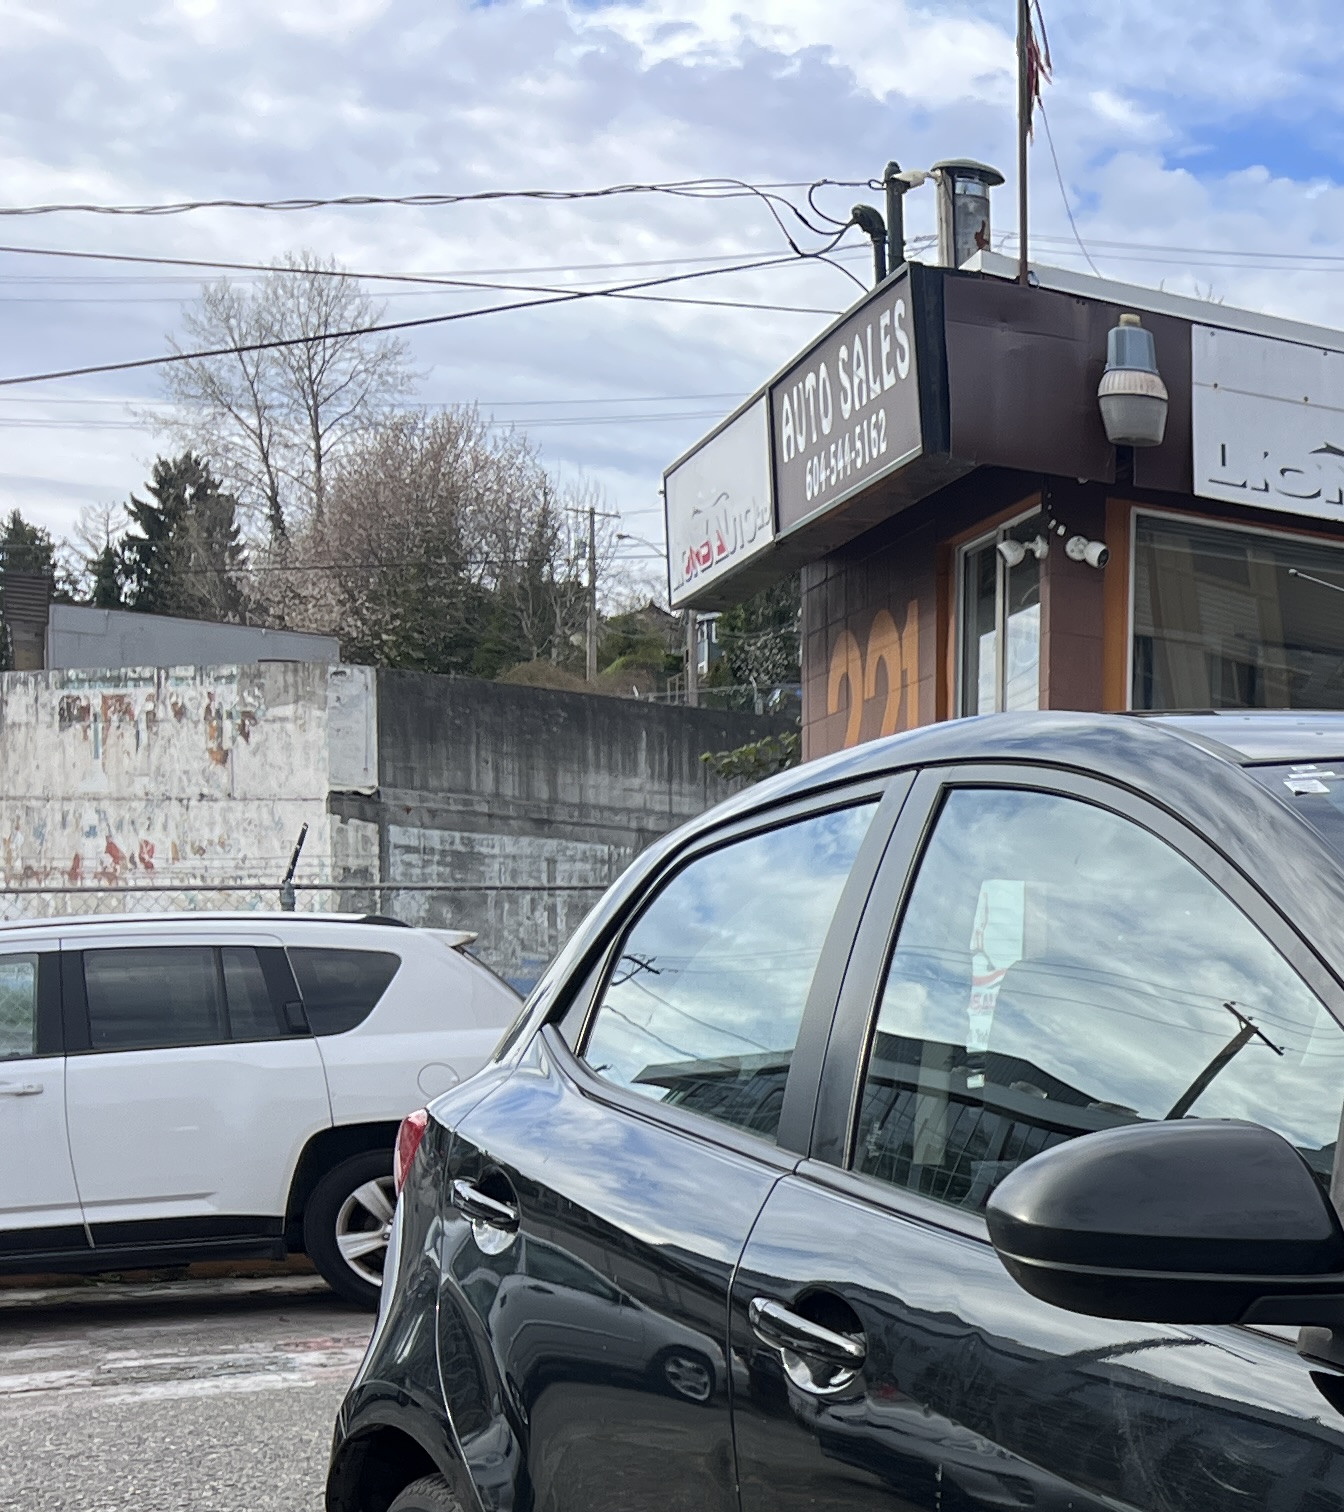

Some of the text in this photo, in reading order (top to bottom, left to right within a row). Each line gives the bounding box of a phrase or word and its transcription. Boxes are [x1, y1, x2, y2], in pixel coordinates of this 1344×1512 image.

[782, 299, 910, 463] AUTO SALES
[805, 408, 887, 501] 604-544-5162
